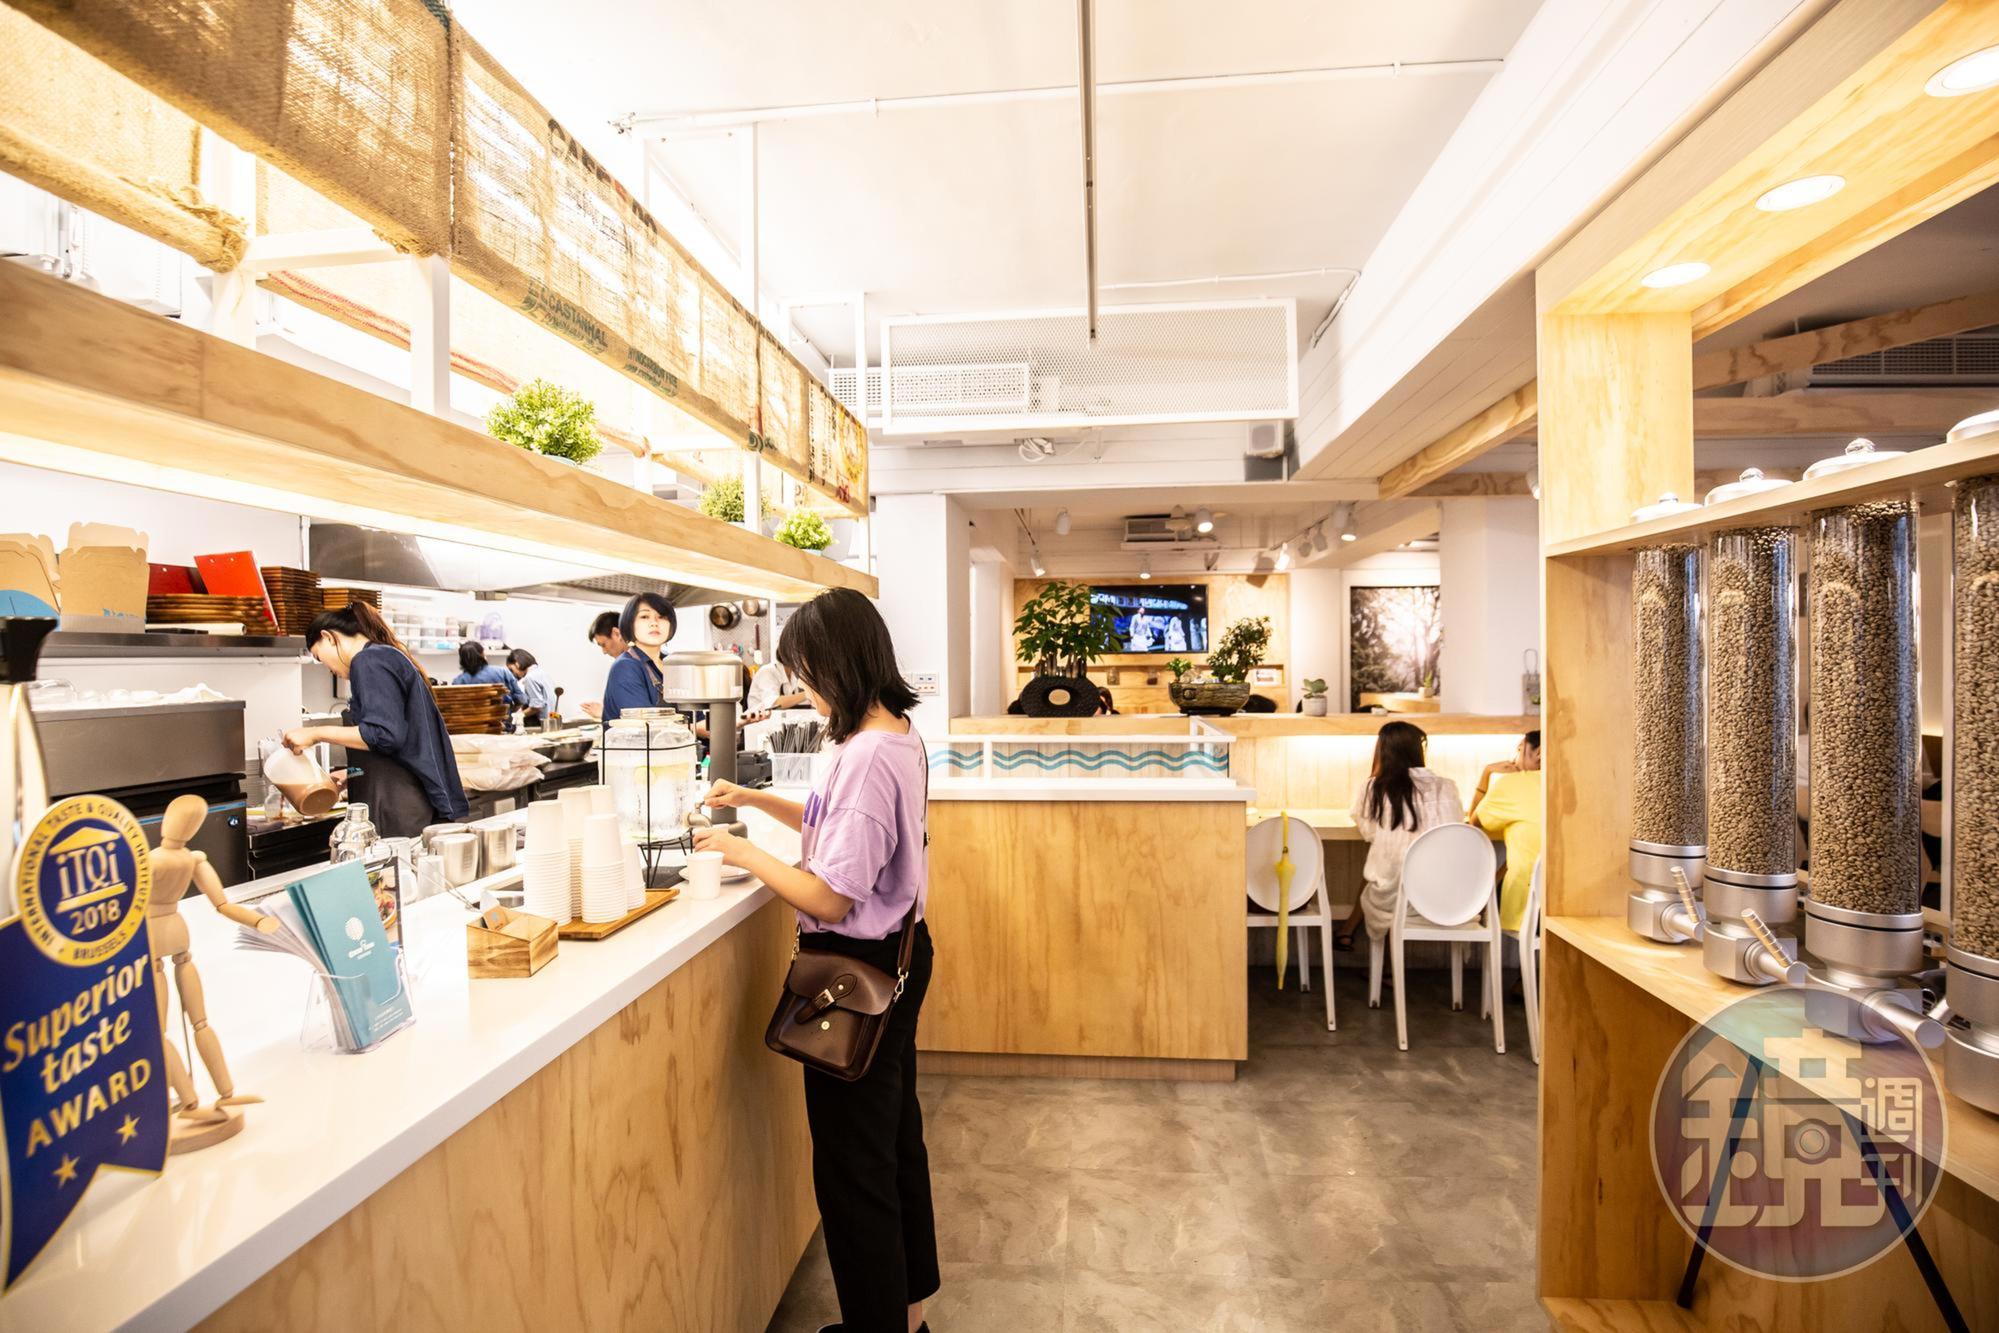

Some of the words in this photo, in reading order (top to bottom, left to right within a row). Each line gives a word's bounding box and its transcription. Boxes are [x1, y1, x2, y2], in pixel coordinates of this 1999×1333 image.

[21, 832, 56, 947] INTERNATIONAL
[47, 802, 82, 829] TASTE
[98, 803, 139, 840] QUALITY
[133, 841, 151, 913] INSTITUTE
[69, 898, 122, 936] 2018
[72, 930, 128, 961] BRUSSELS
[3, 953, 149, 1073] Superior
[40, 1009, 131, 1095] taste
[26, 1057, 151, 1158] AWARD
